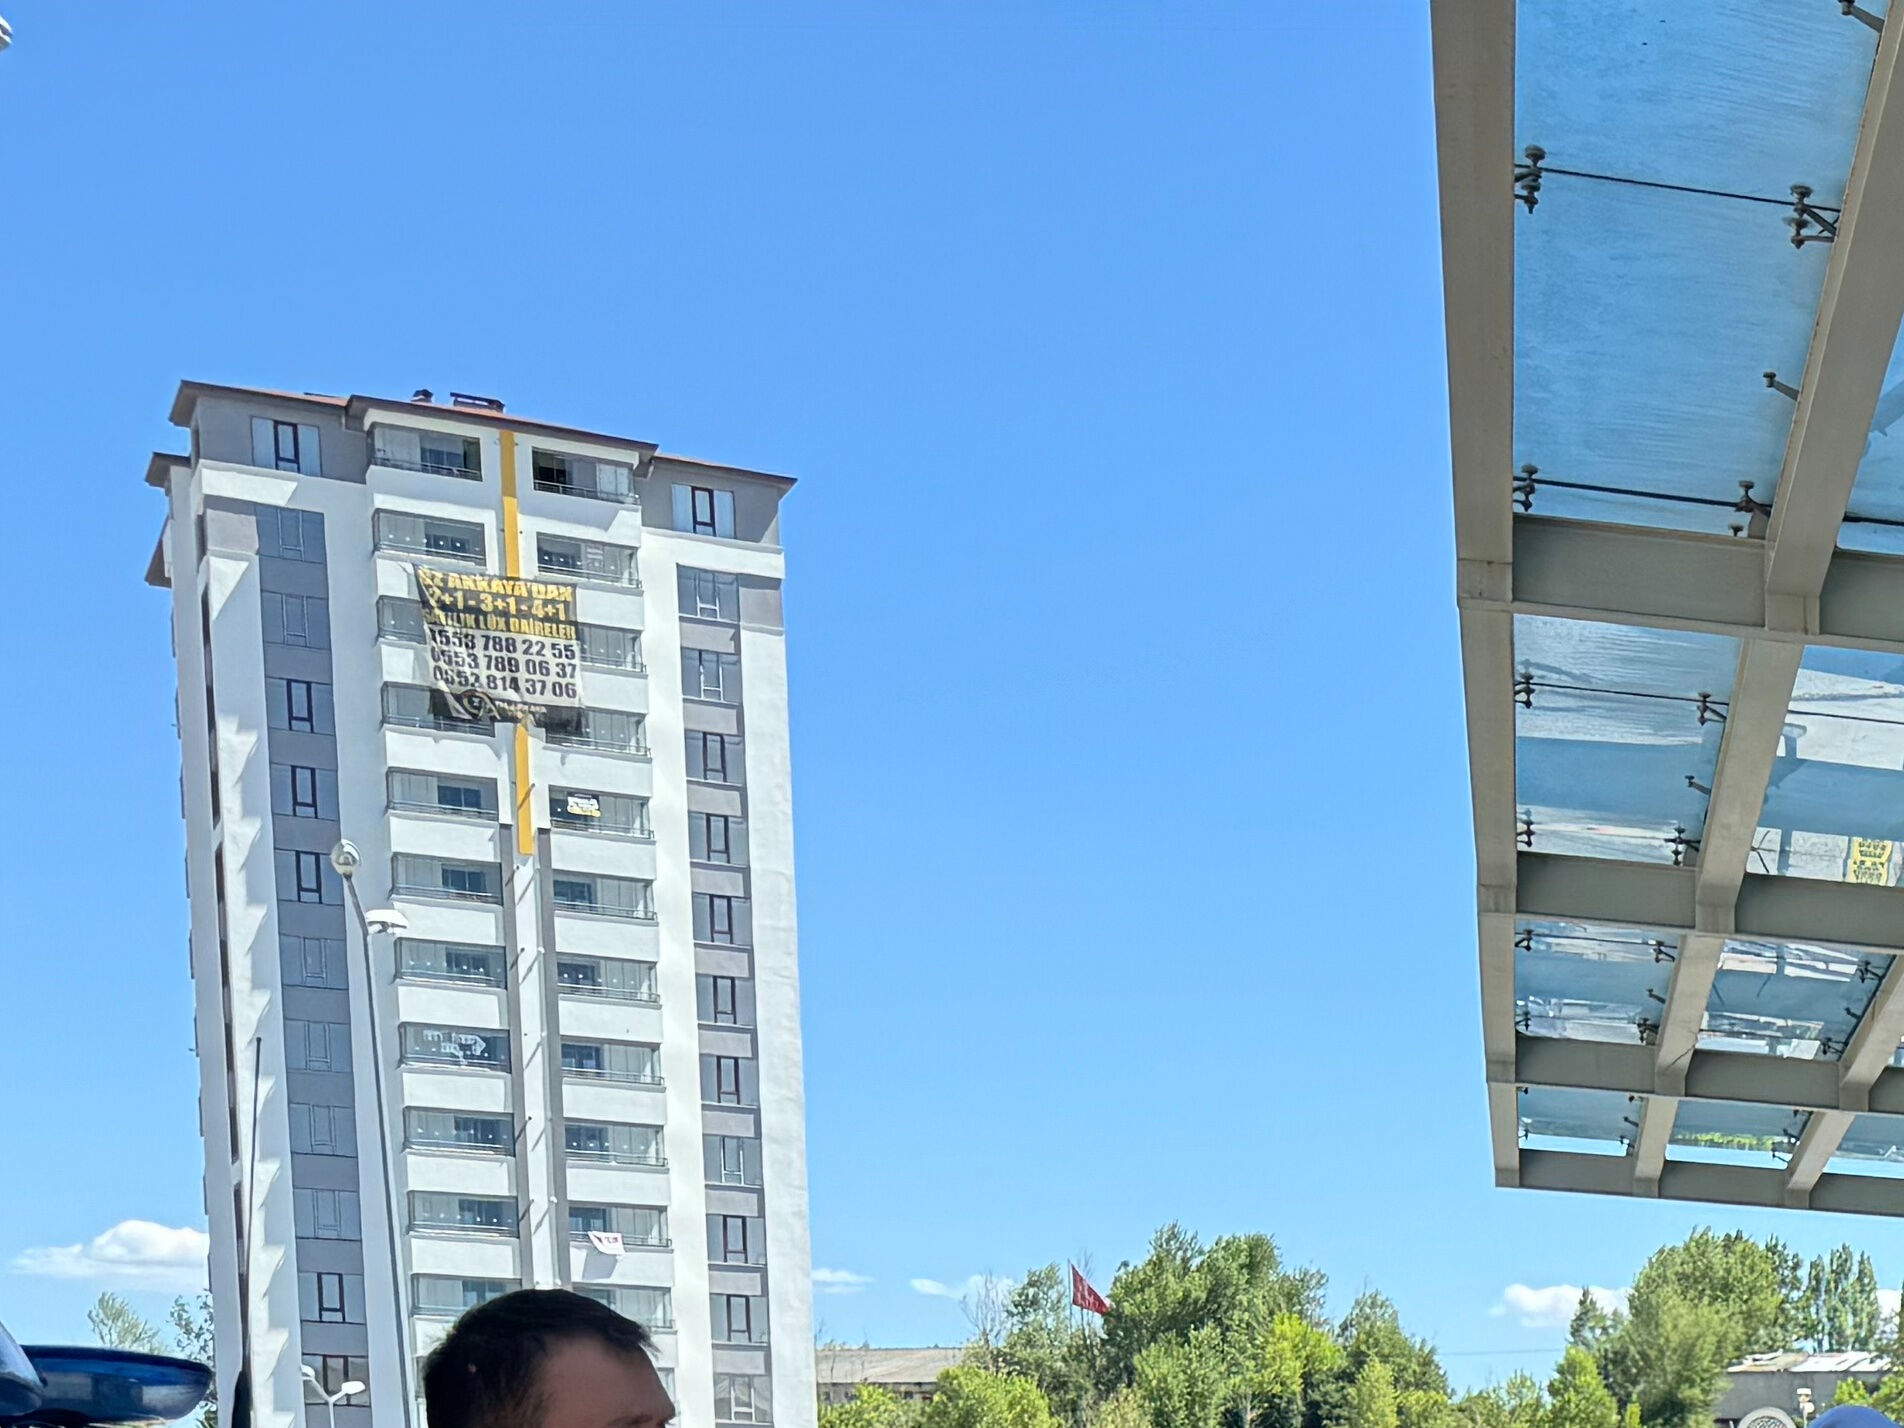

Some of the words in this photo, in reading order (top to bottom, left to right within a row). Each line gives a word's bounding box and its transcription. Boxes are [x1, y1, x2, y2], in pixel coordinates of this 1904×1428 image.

[479, 593, 518, 615] 3+1
[531, 599, 566, 622] 4+1
[522, 639, 546, 657] 22
[551, 643, 576, 660] 55
[484, 654, 520, 673] 789
[525, 659, 551, 677] 06
[555, 662, 577, 679] 37
[525, 679, 547, 696] 37
[552, 682, 577, 699] 06
